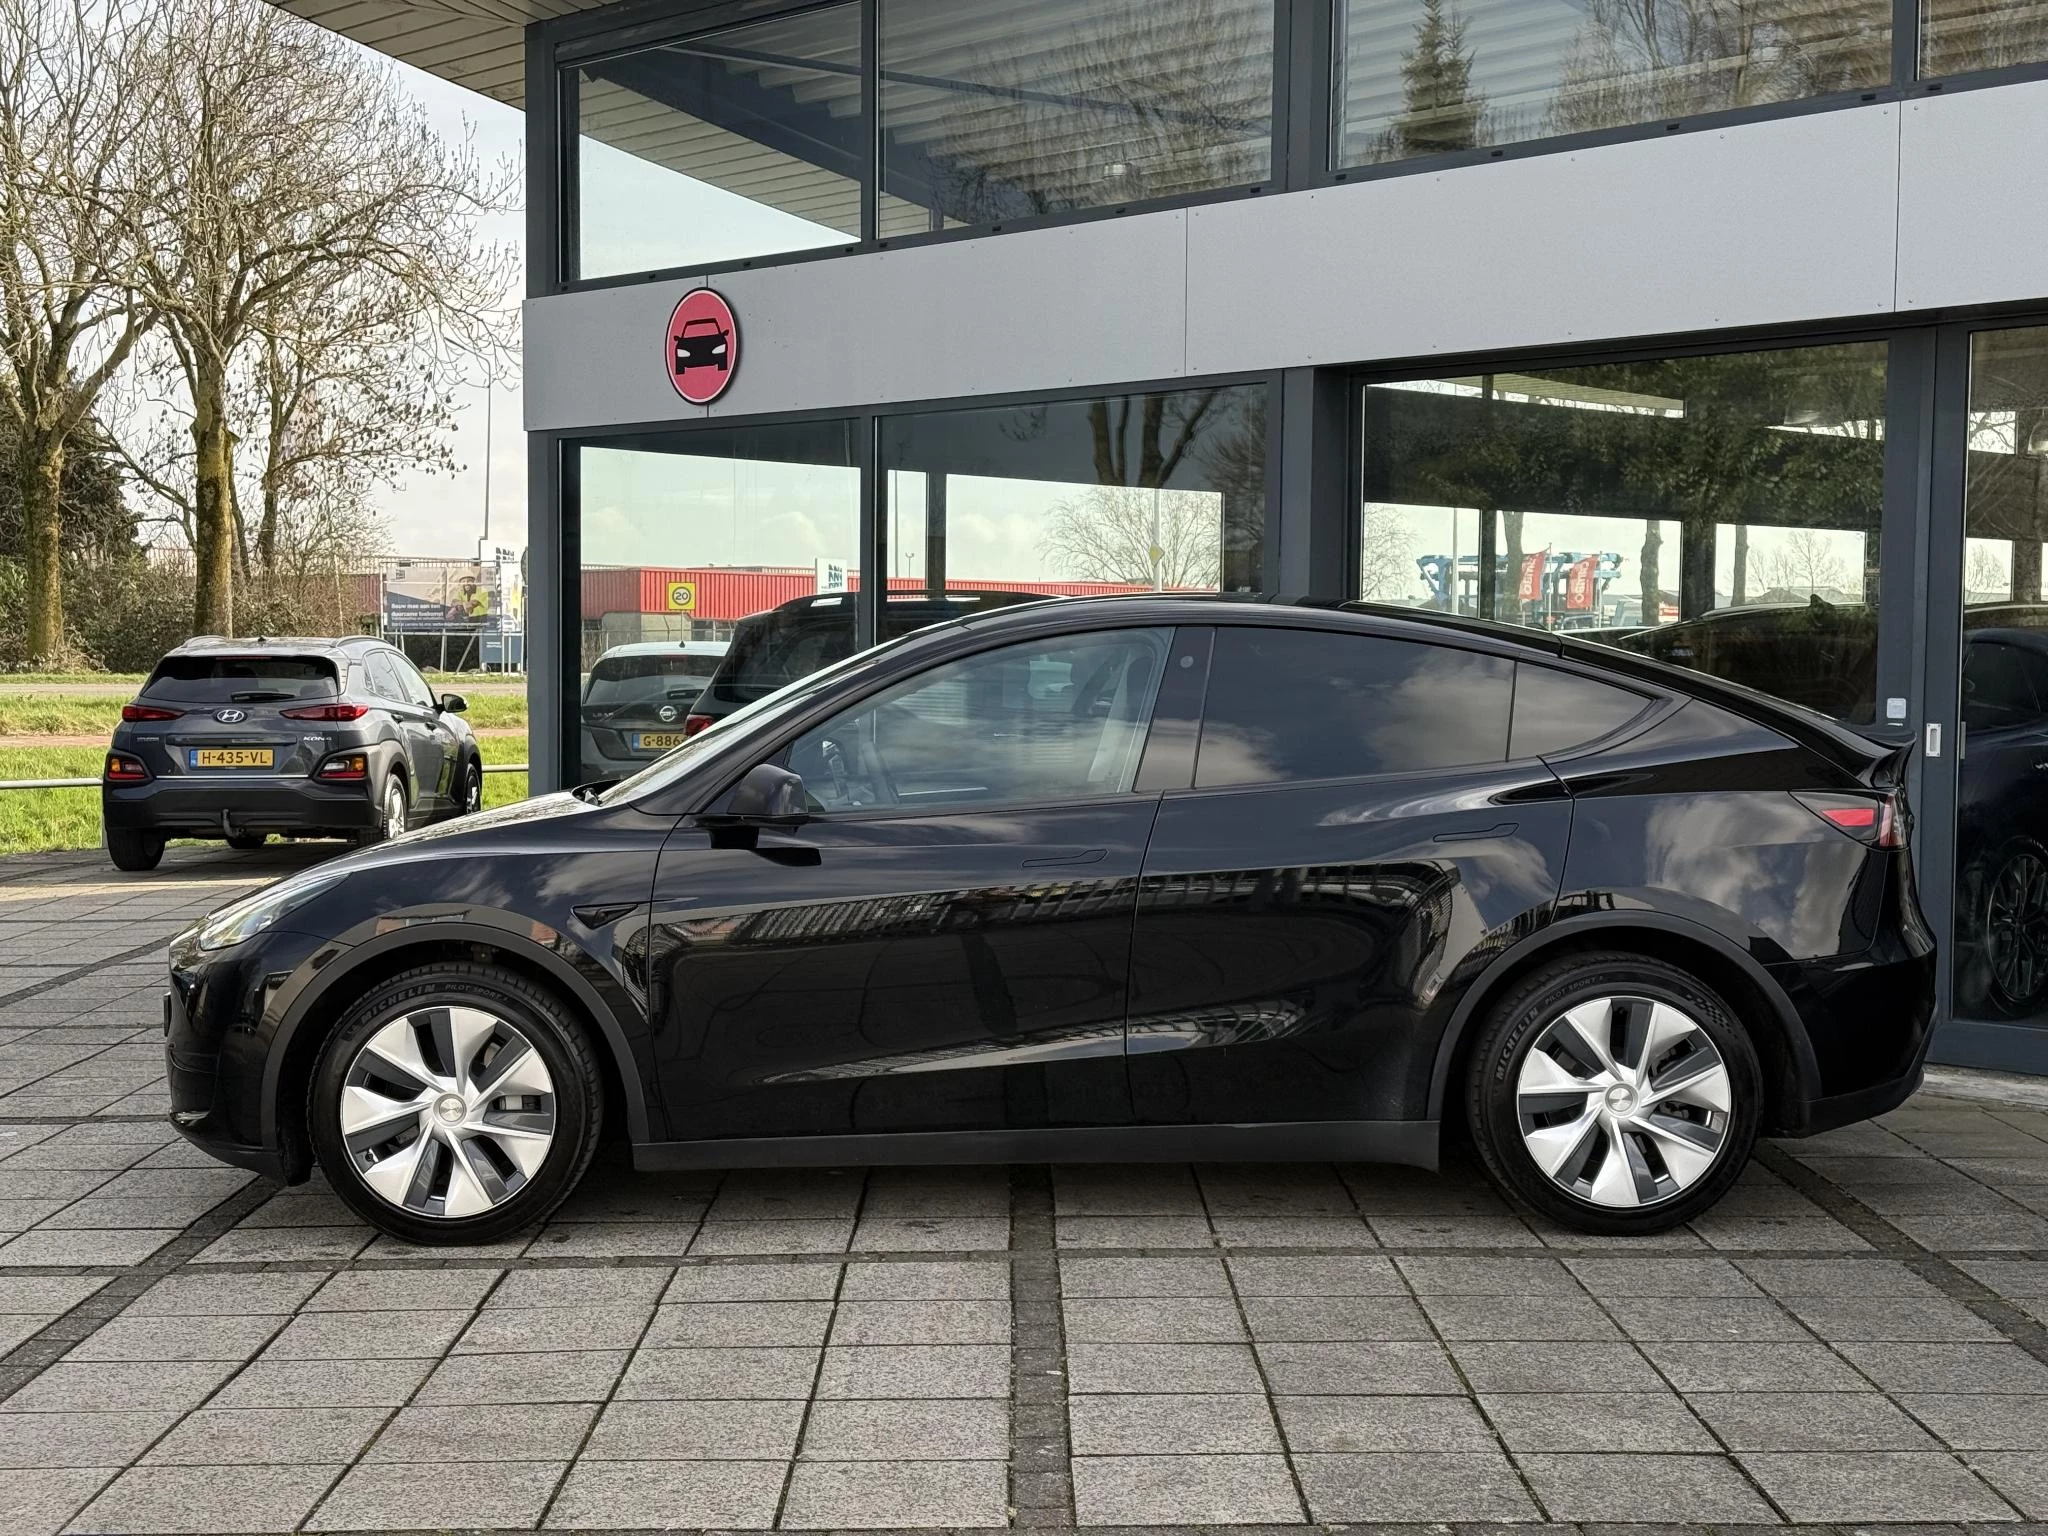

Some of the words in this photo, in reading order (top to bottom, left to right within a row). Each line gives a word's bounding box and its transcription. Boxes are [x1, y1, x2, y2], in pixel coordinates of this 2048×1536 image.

[675, 591, 688, 600] 20
[202, 751, 267, 765] H-435-VL
[361, 983, 435, 1024] MICHELIN
[1496, 1007, 1539, 1080] MICHELIN
